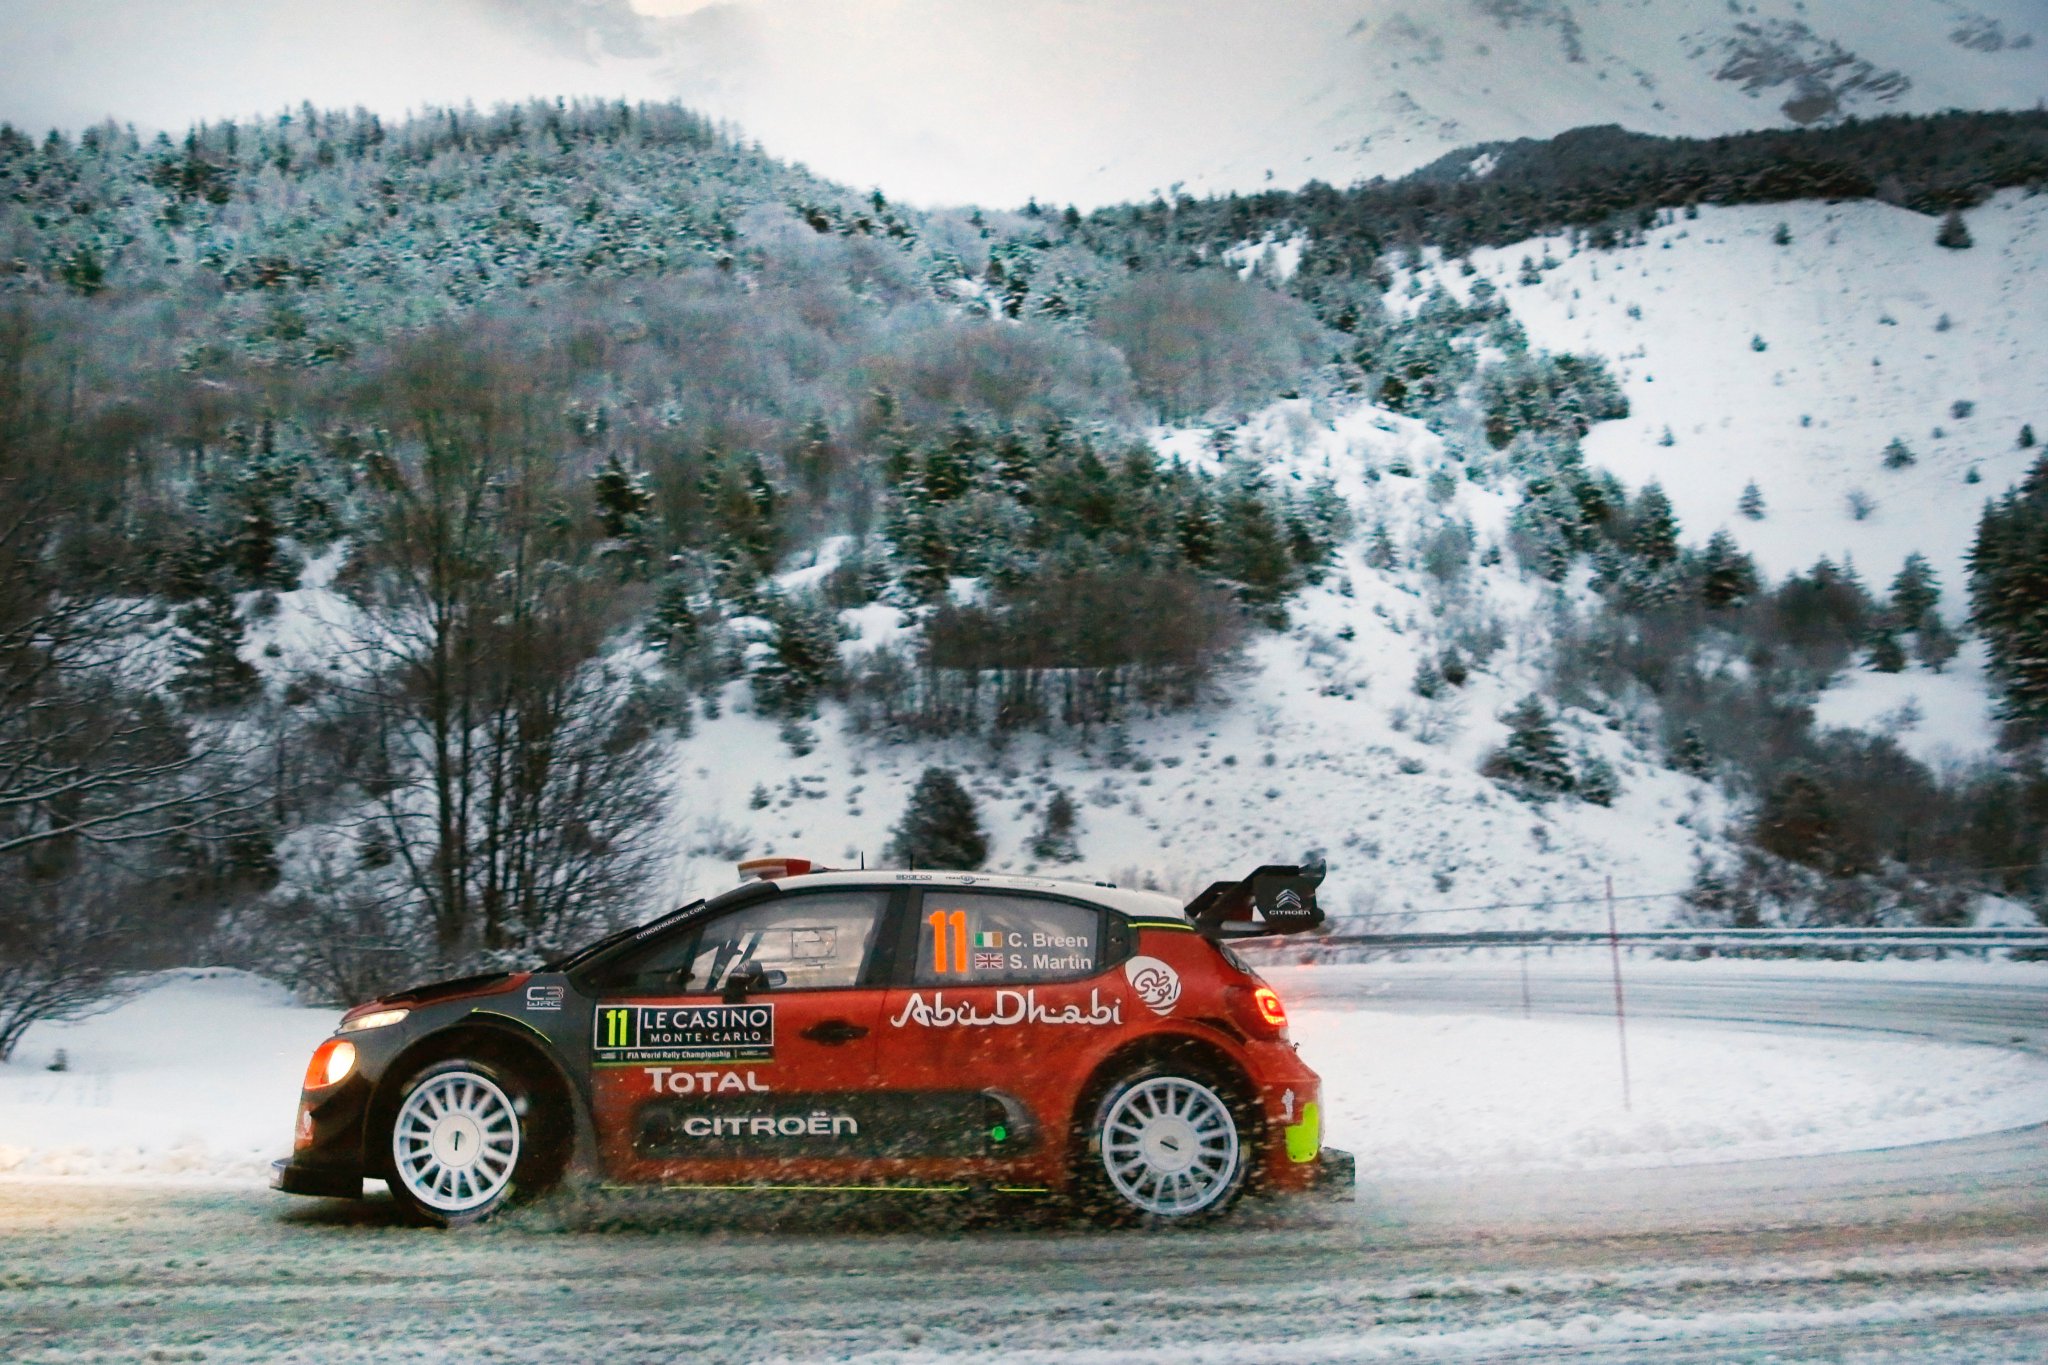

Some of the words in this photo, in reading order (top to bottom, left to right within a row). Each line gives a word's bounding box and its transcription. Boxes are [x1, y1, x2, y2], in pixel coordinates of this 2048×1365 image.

[929, 910, 968, 974] 11
[1008, 933, 1028, 948] C.
[1032, 933, 1088, 948] Breen
[1009, 954, 1028, 970] S.
[1033, 954, 1092, 970] Martin
[527, 986, 564, 1000] C3
[606, 1009, 628, 1047] 11
[644, 1012, 666, 1029] LE
[673, 1009, 768, 1029] CASINO
[627, 1051, 639, 1059] FIA
[640, 1051, 661, 1059] World
[663, 1051, 680, 1060] Rally
[682, 1050, 731, 1060] Championship
[644, 1067, 769, 1093] TOTAL
